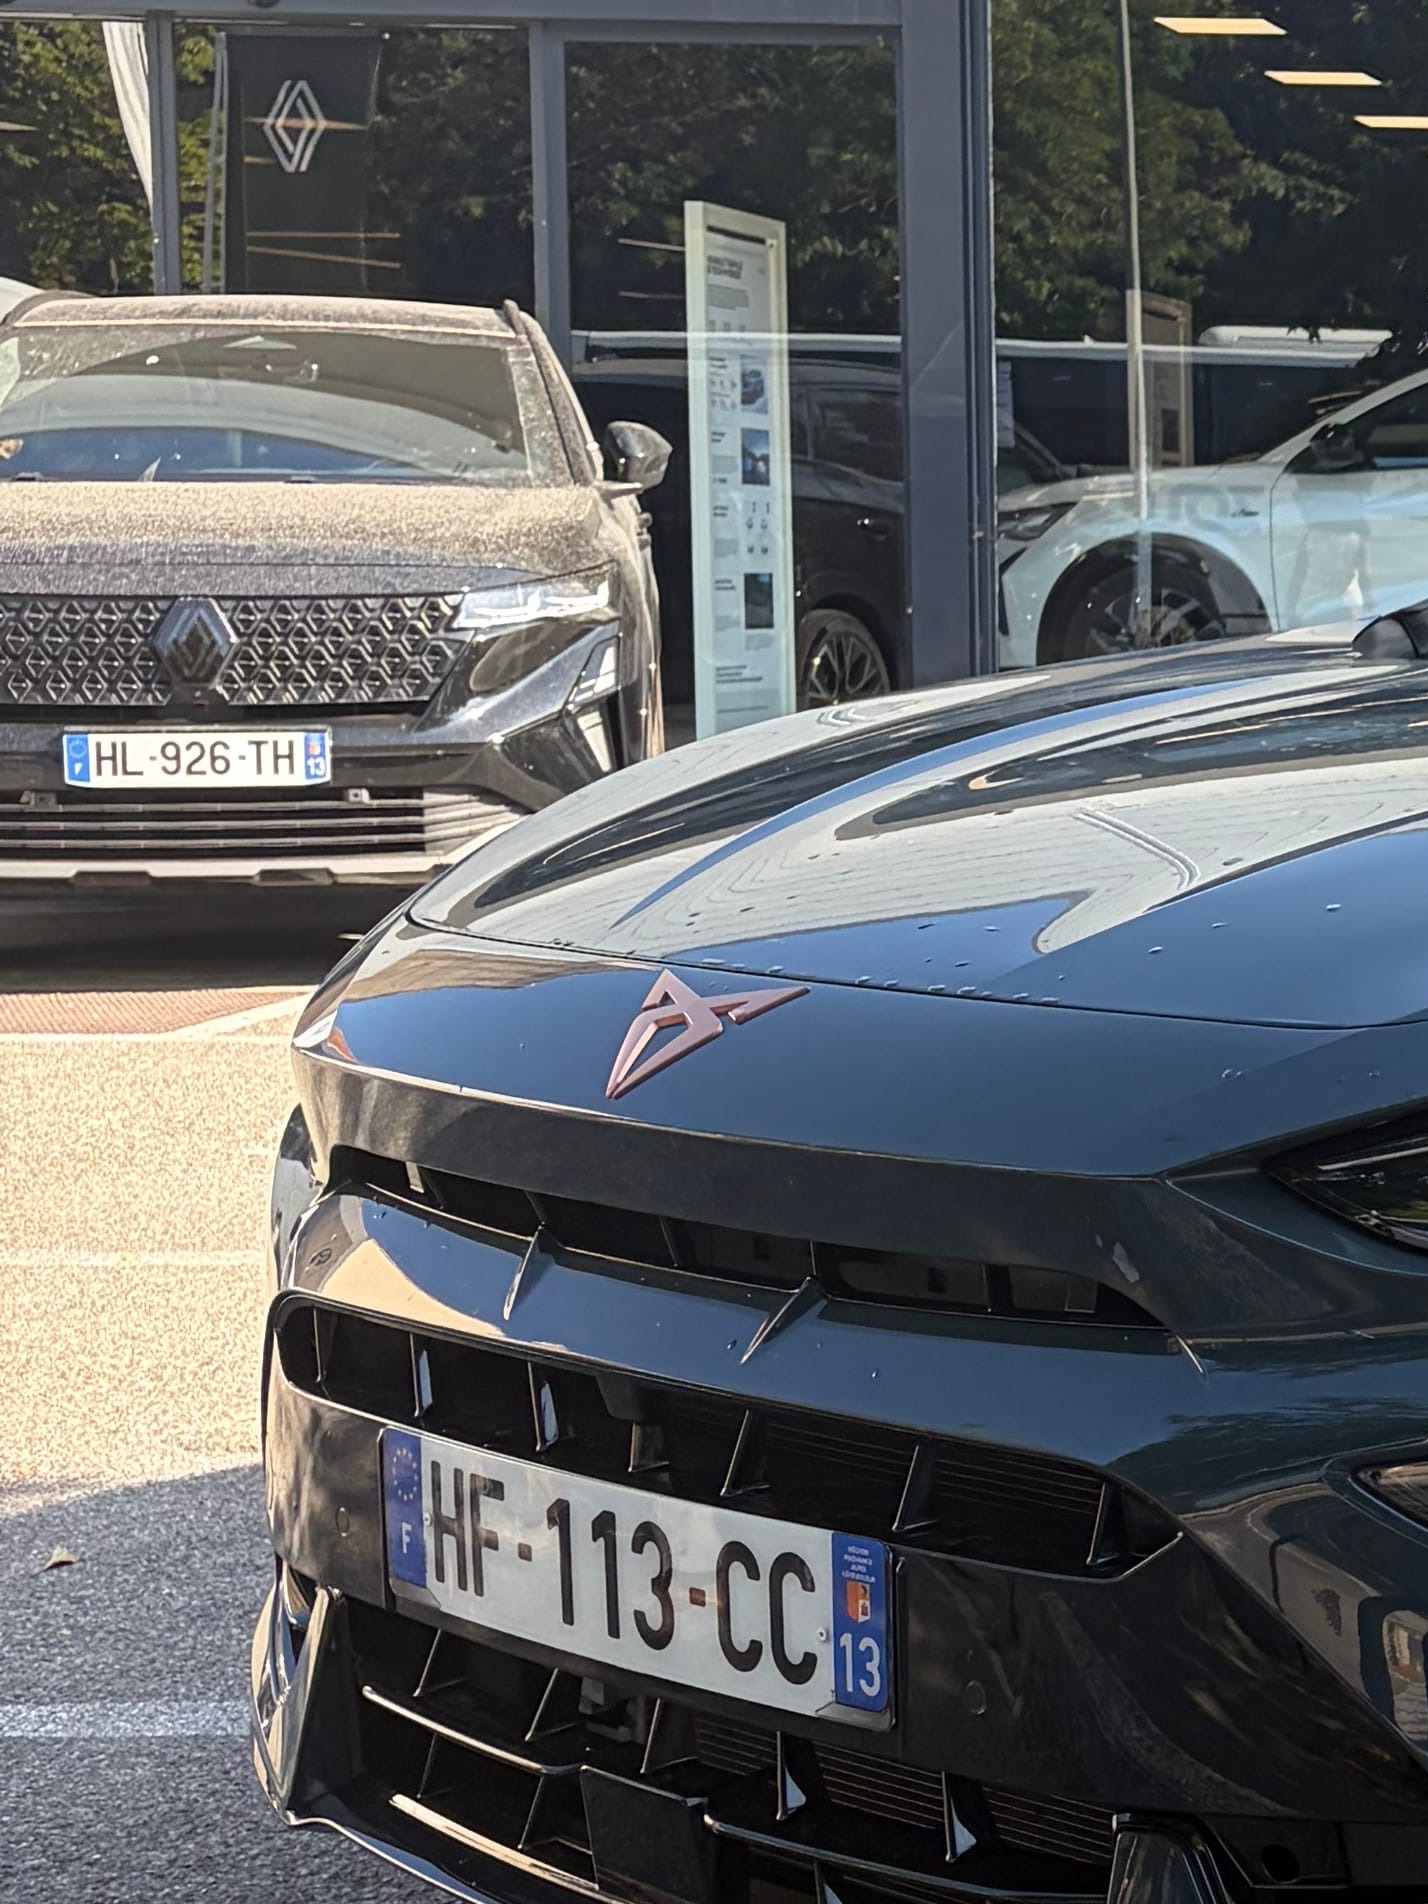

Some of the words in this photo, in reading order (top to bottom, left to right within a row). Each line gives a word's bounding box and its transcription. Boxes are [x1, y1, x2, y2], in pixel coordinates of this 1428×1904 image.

[95, 739, 295, 777] HL-926-TH
[307, 757, 326, 776] 13
[400, 1521, 413, 1554] F
[431, 1460, 818, 1685] HF-113-CC
[839, 1632, 881, 1697] 13
